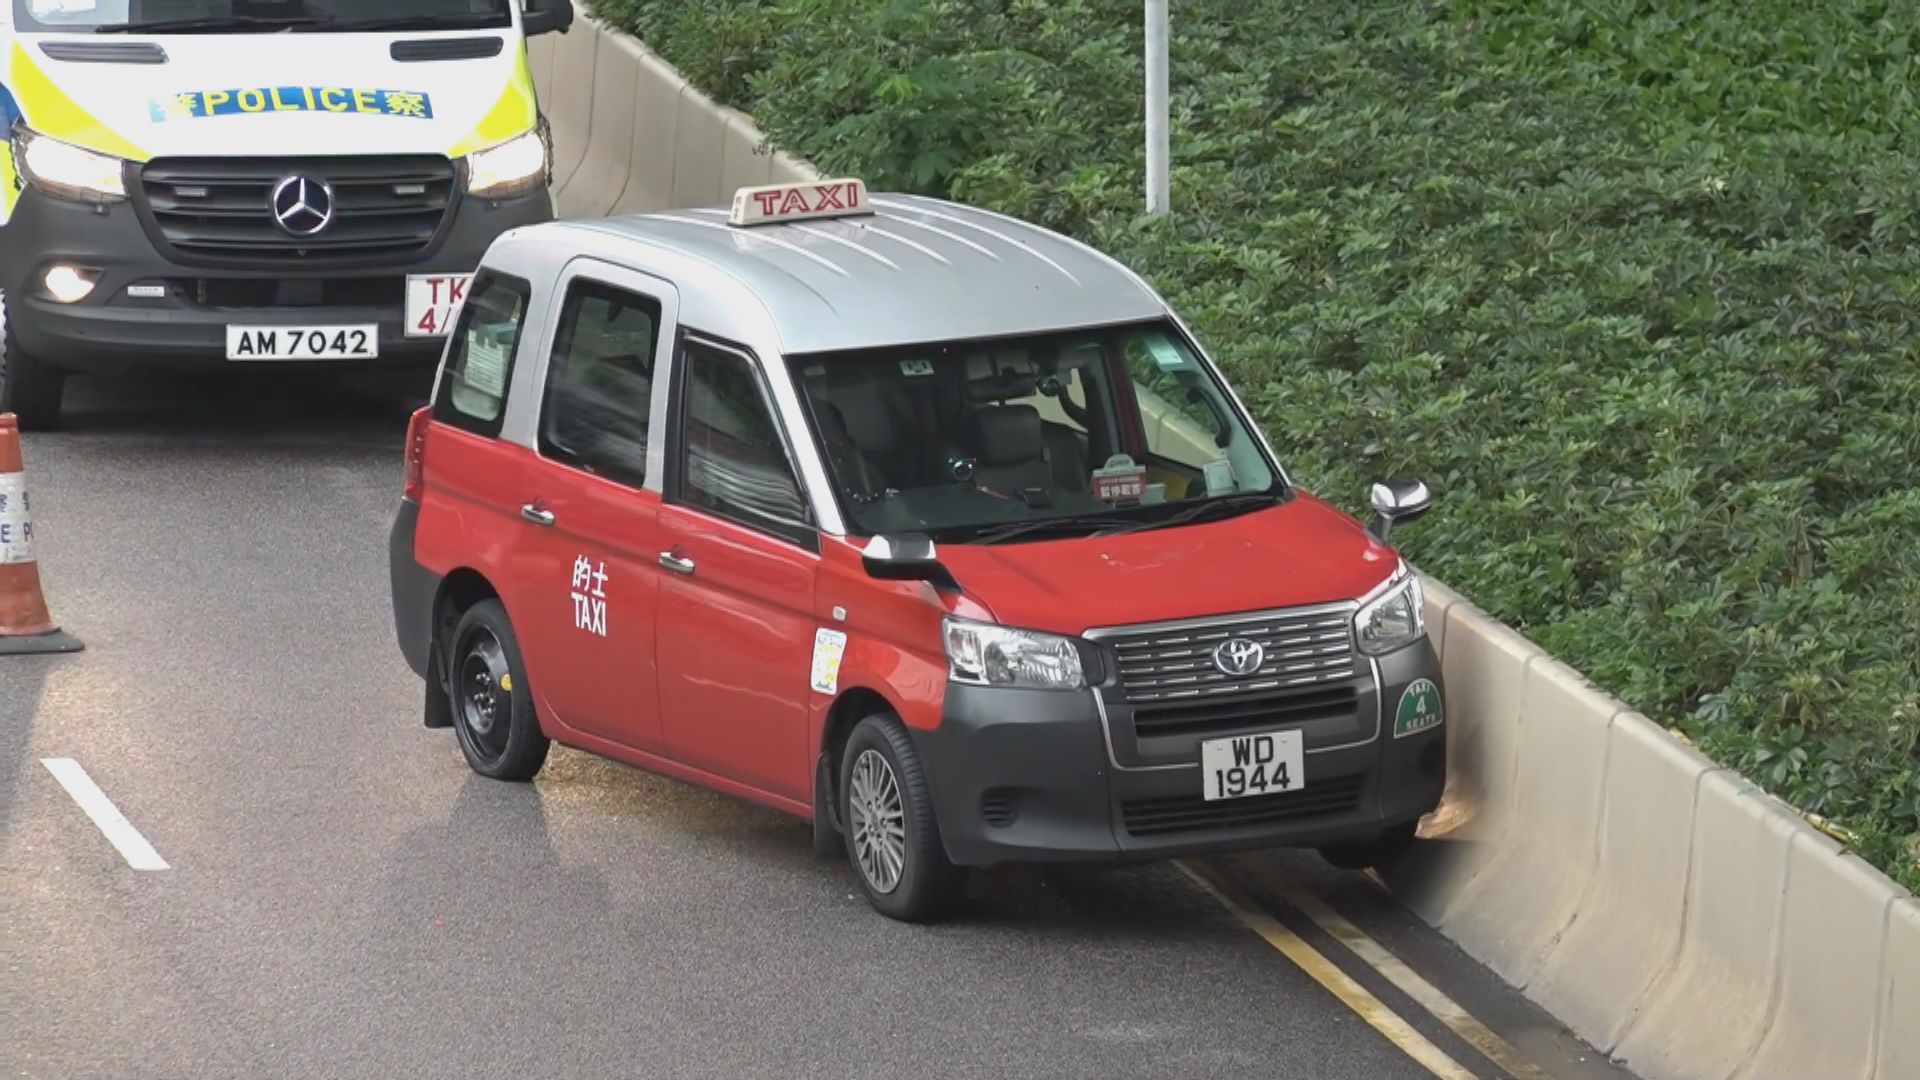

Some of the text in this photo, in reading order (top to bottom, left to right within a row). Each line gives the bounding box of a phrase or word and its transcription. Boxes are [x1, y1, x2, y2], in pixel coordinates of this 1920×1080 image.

[202, 86, 381, 116] POLICE
[383, 91, 427, 118] 察
[753, 182, 858, 216] TAXI
[237, 330, 368, 355] AM 7042
[572, 554, 608, 598] 的士
[571, 591, 606, 637] TAXI
[1416, 695, 1426, 714] 4
[1231, 735, 1274, 767] WD
[1216, 761, 1290, 797] 1944
